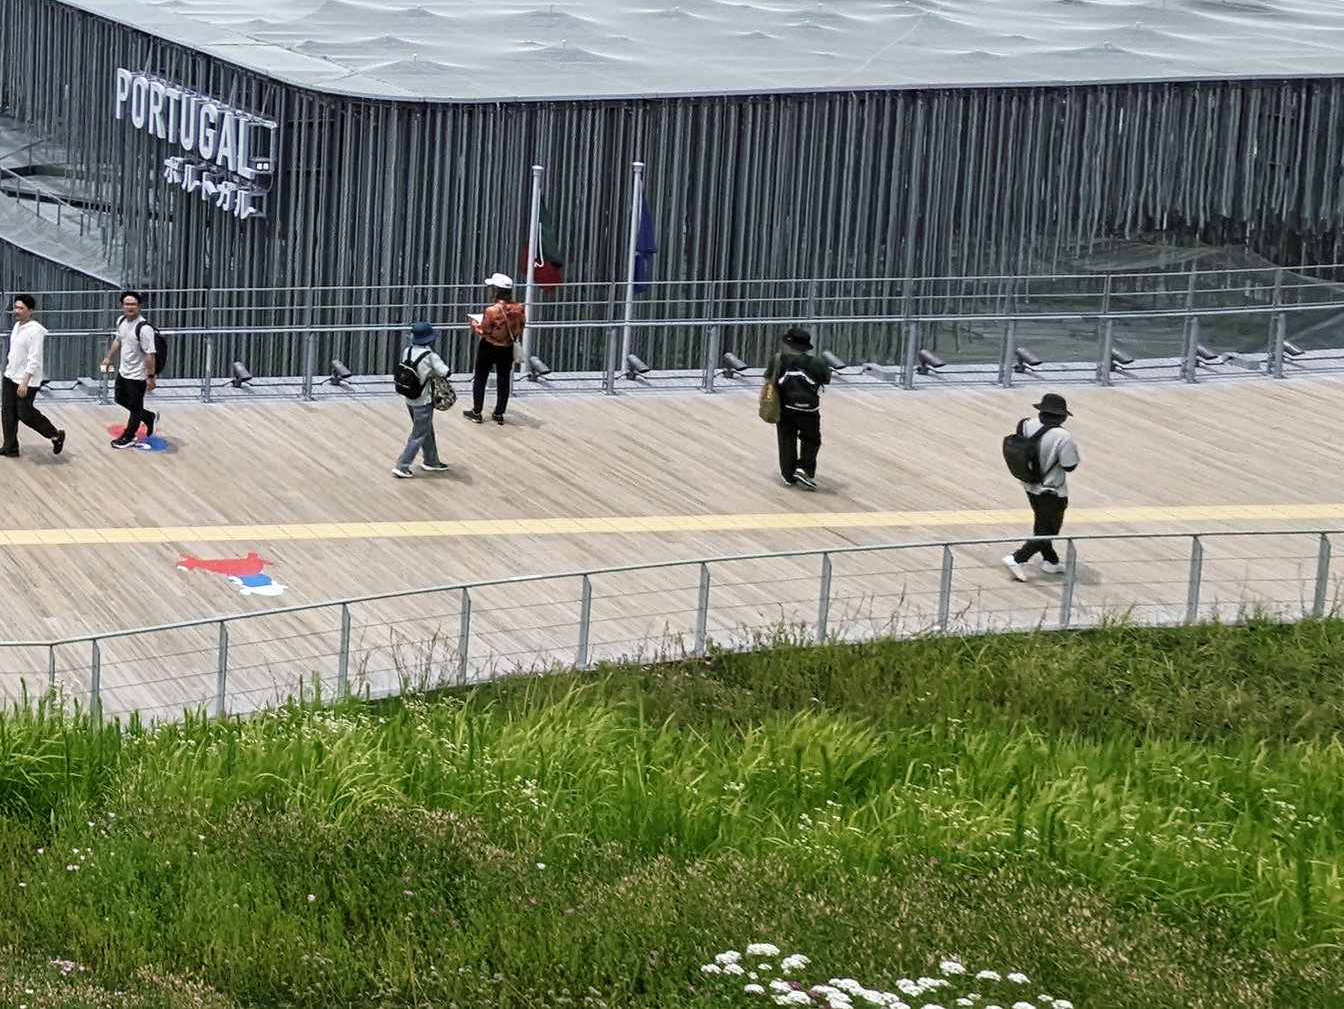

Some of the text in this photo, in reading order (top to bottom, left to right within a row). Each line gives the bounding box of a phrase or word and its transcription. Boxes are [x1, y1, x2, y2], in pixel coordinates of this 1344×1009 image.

[115, 67, 256, 180] PORTUGAL
[163, 155, 257, 220] ポルトガル
